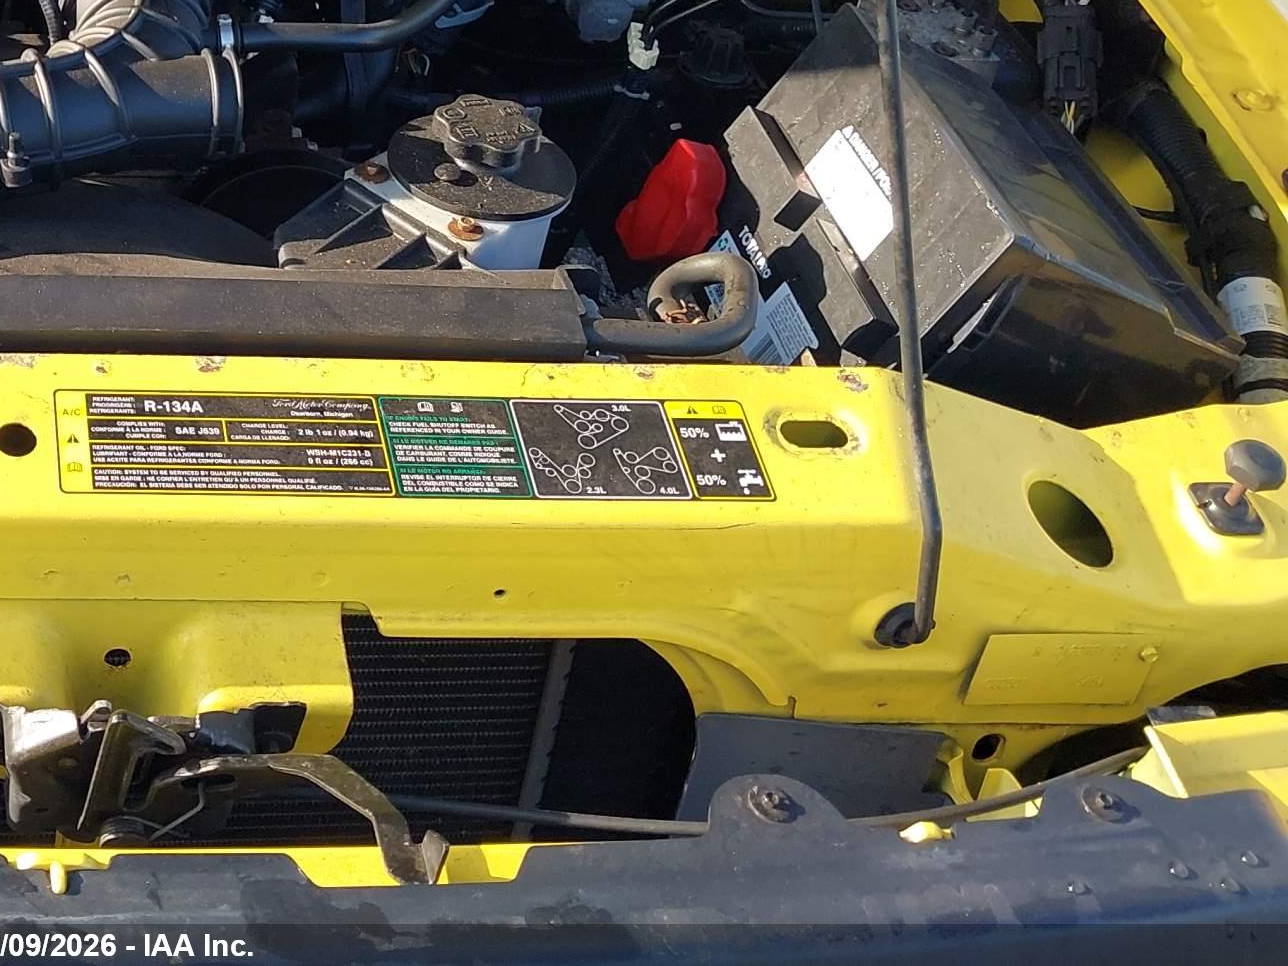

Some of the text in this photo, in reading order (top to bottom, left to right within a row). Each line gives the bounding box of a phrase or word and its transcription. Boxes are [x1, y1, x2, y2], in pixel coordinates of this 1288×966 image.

[143, 400, 204, 413] R-134A
[322, 399, 369, 411] Company
[62, 408, 81, 416] A/C
[175, 427, 220, 435] SAE J639
[360, 430, 374, 438] kg)
[680, 428, 710, 438] 50%
[696, 474, 727, 485] 50%
